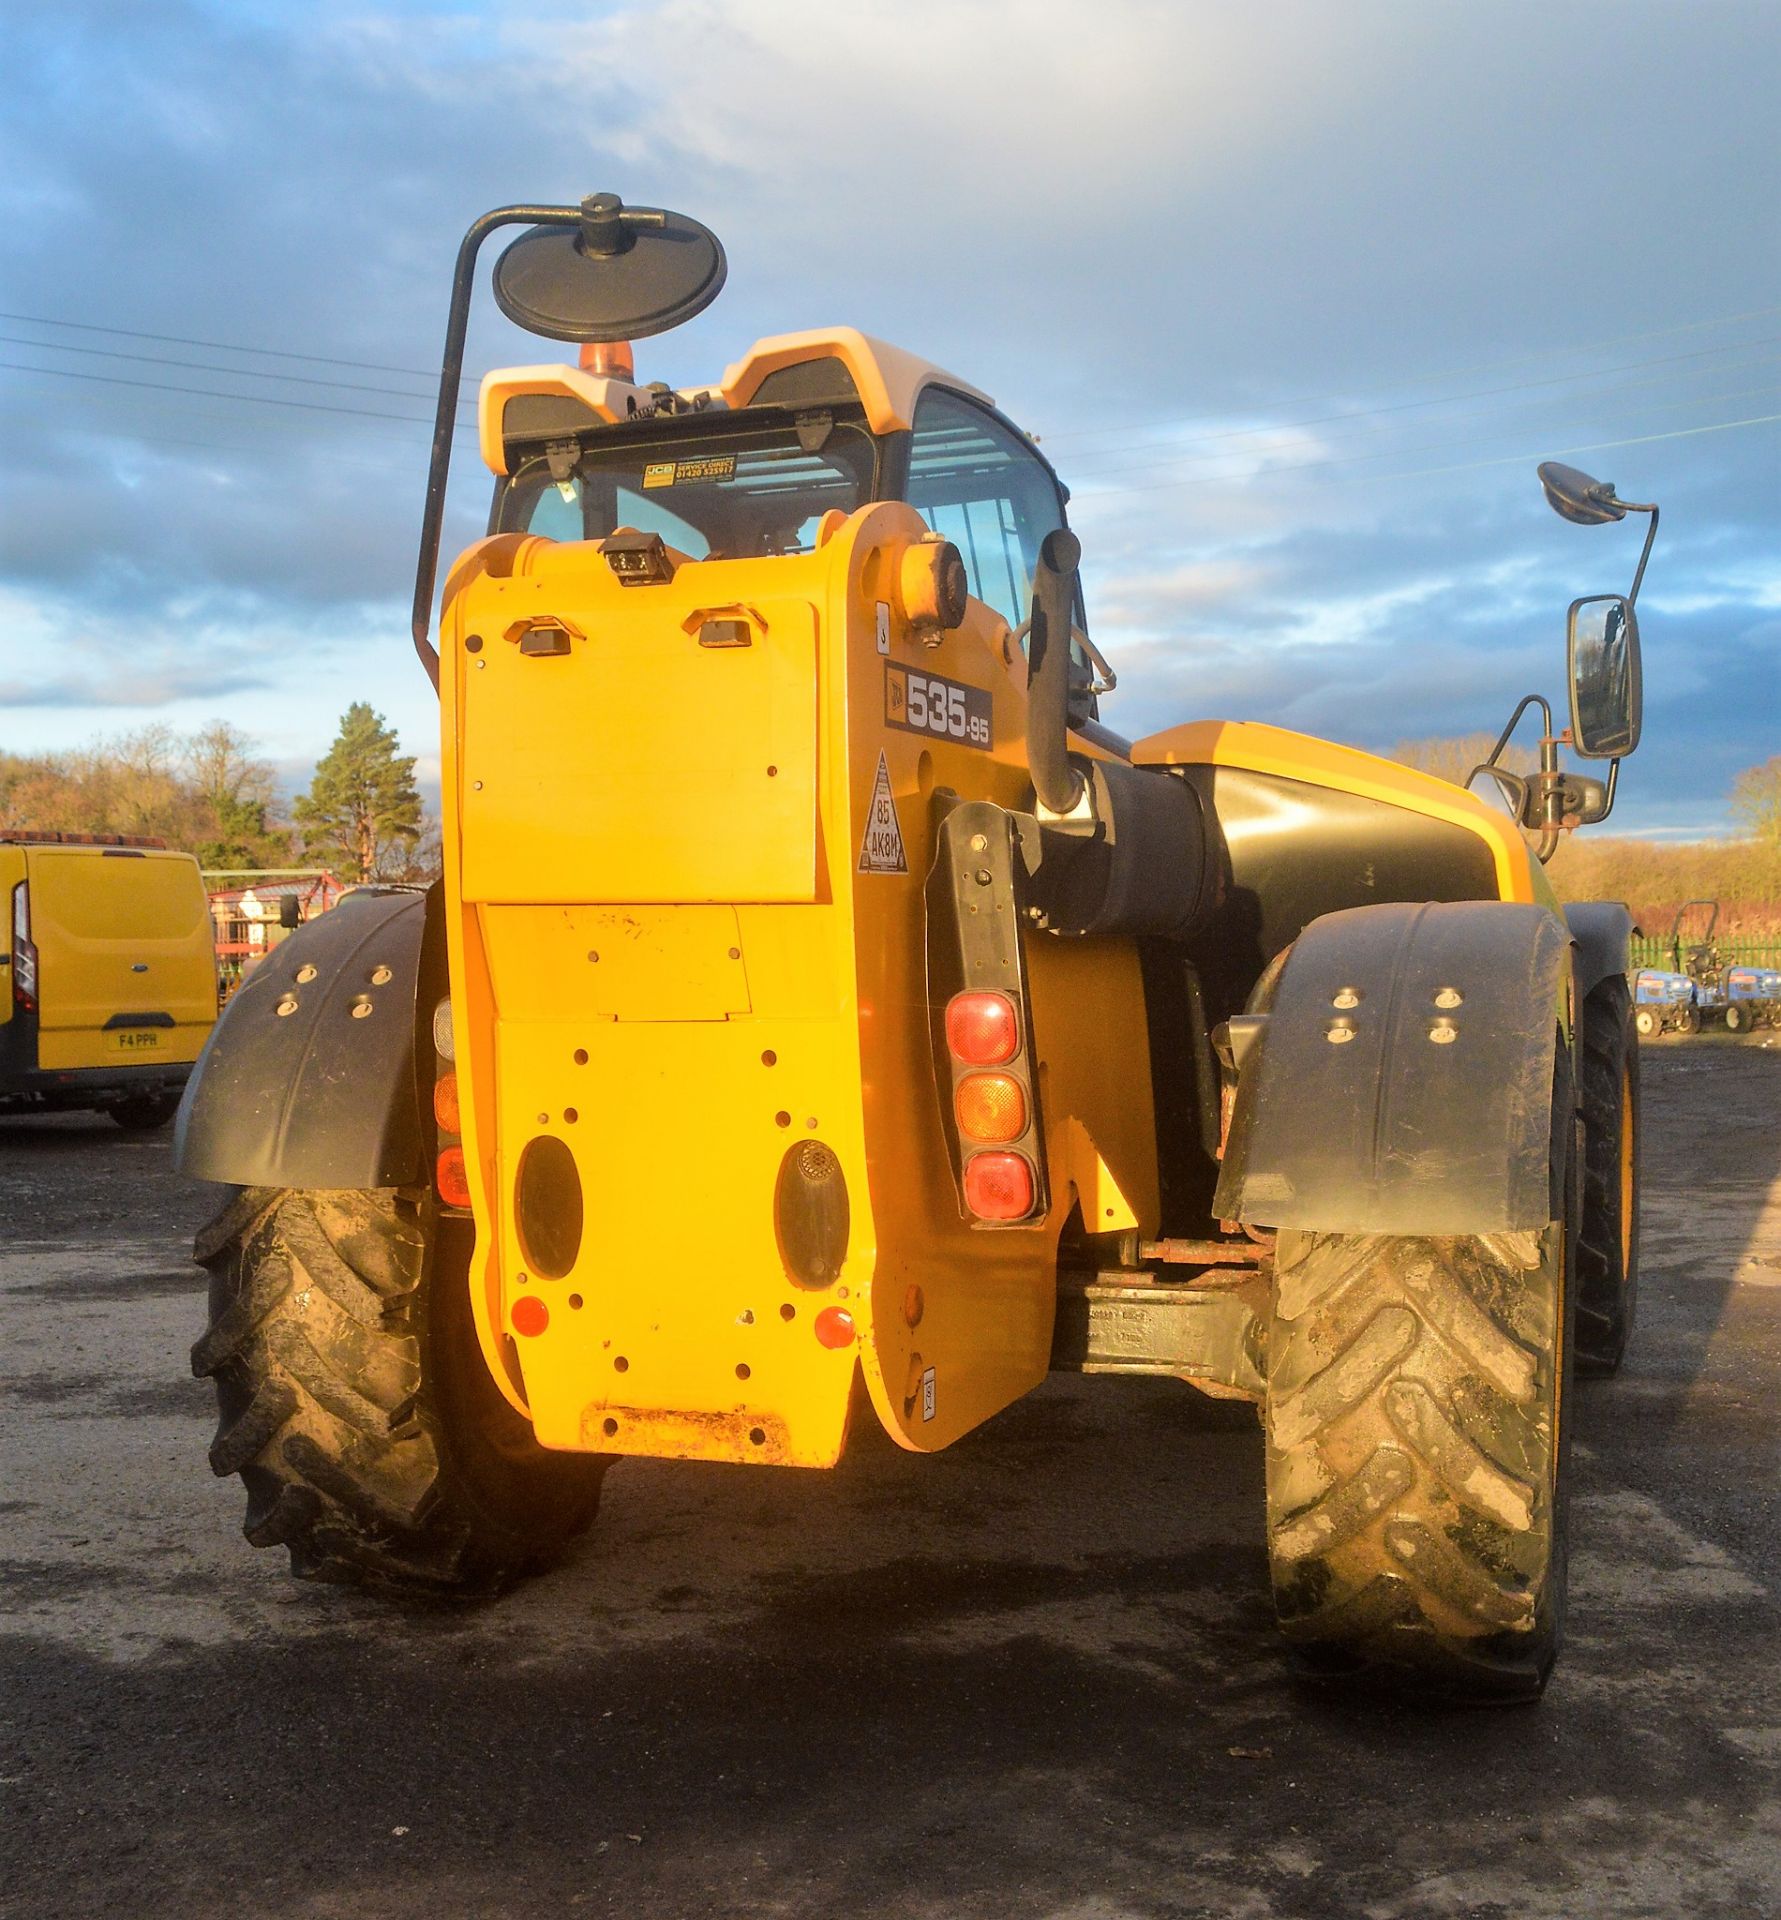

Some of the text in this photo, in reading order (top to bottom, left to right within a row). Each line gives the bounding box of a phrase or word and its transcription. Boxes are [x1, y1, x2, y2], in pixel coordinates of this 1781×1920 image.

[647, 465, 673, 475] JCB
[677, 463, 706, 471] SERVICE
[676, 469, 702, 478] 01420
[877, 799, 890, 825] 85
[119, 1034, 134, 1048] F4
